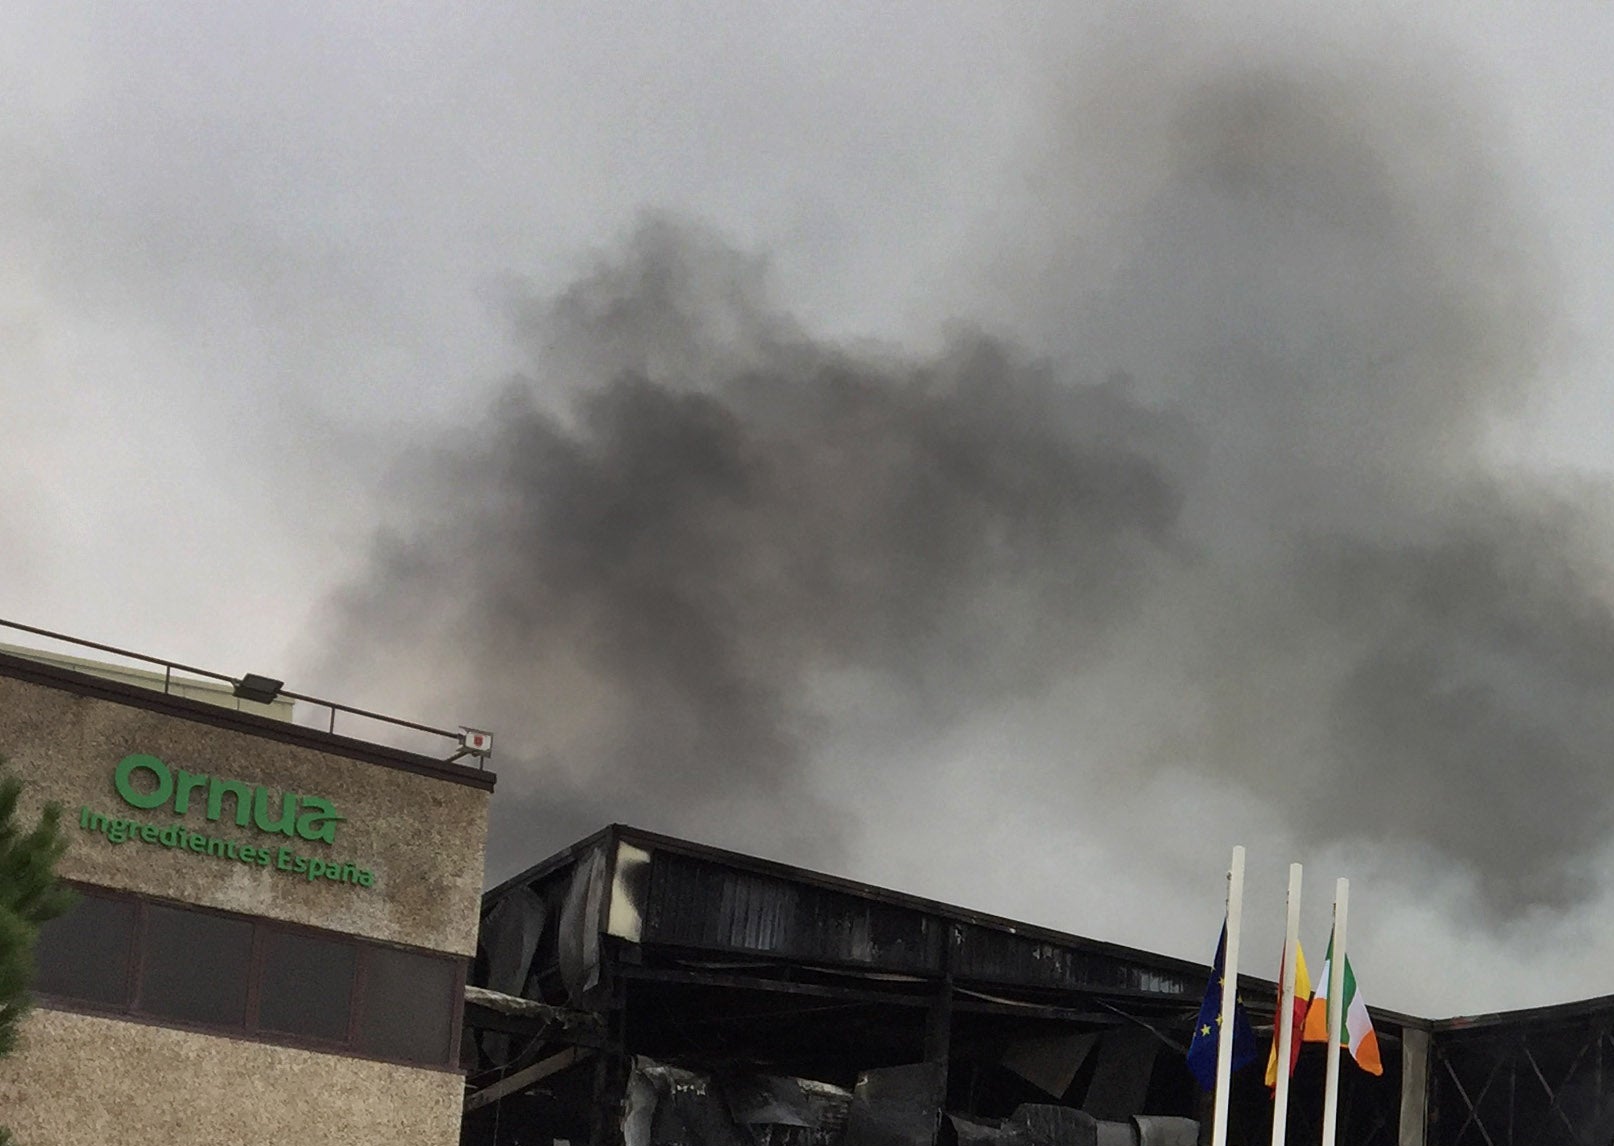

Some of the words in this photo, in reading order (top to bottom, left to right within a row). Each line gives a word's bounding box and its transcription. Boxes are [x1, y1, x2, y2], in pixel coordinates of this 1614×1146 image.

[115, 753, 347, 844] Ornua
[79, 805, 271, 866] Ingredientes
[276, 846, 376, 888] España
